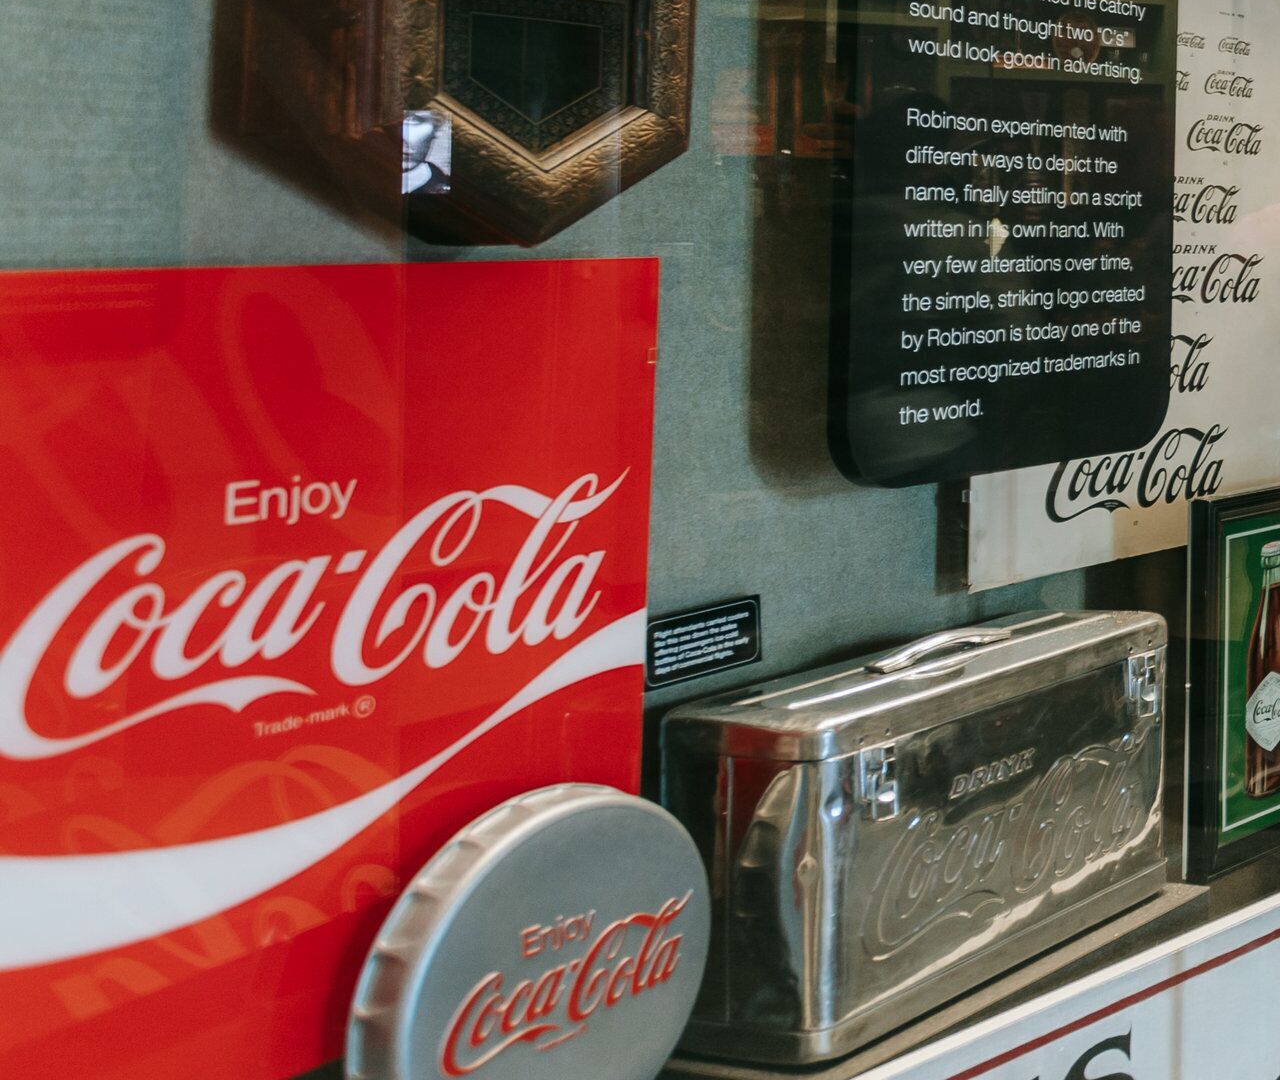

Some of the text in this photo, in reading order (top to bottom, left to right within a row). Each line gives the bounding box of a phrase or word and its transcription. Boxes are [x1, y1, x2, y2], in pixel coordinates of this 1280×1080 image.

[909, 1, 964, 23] sound
[967, 10, 1000, 28] and
[1002, 13, 1064, 40] thought
[1065, 23, 1094, 42] two
[908, 38, 1143, 85] would look good in advertising.
[1204, 72, 1254, 99] Coca-Cola
[1186, 118, 1265, 156] Coca-Cola
[1206, 113, 1235, 123] DRINK
[1173, 244, 1218, 255] DRINK
[1044, 422, 1231, 524] Coca-Cola
[223, 477, 358, 526] Enjoy
[0, 466, 631, 760] Coca-Cola
[948, 747, 1037, 801] DRINK
[861, 723, 1153, 963] Coca-Cola
[520, 908, 598, 961] Enjoy
[438, 887, 695, 1077] Coca-Cola
